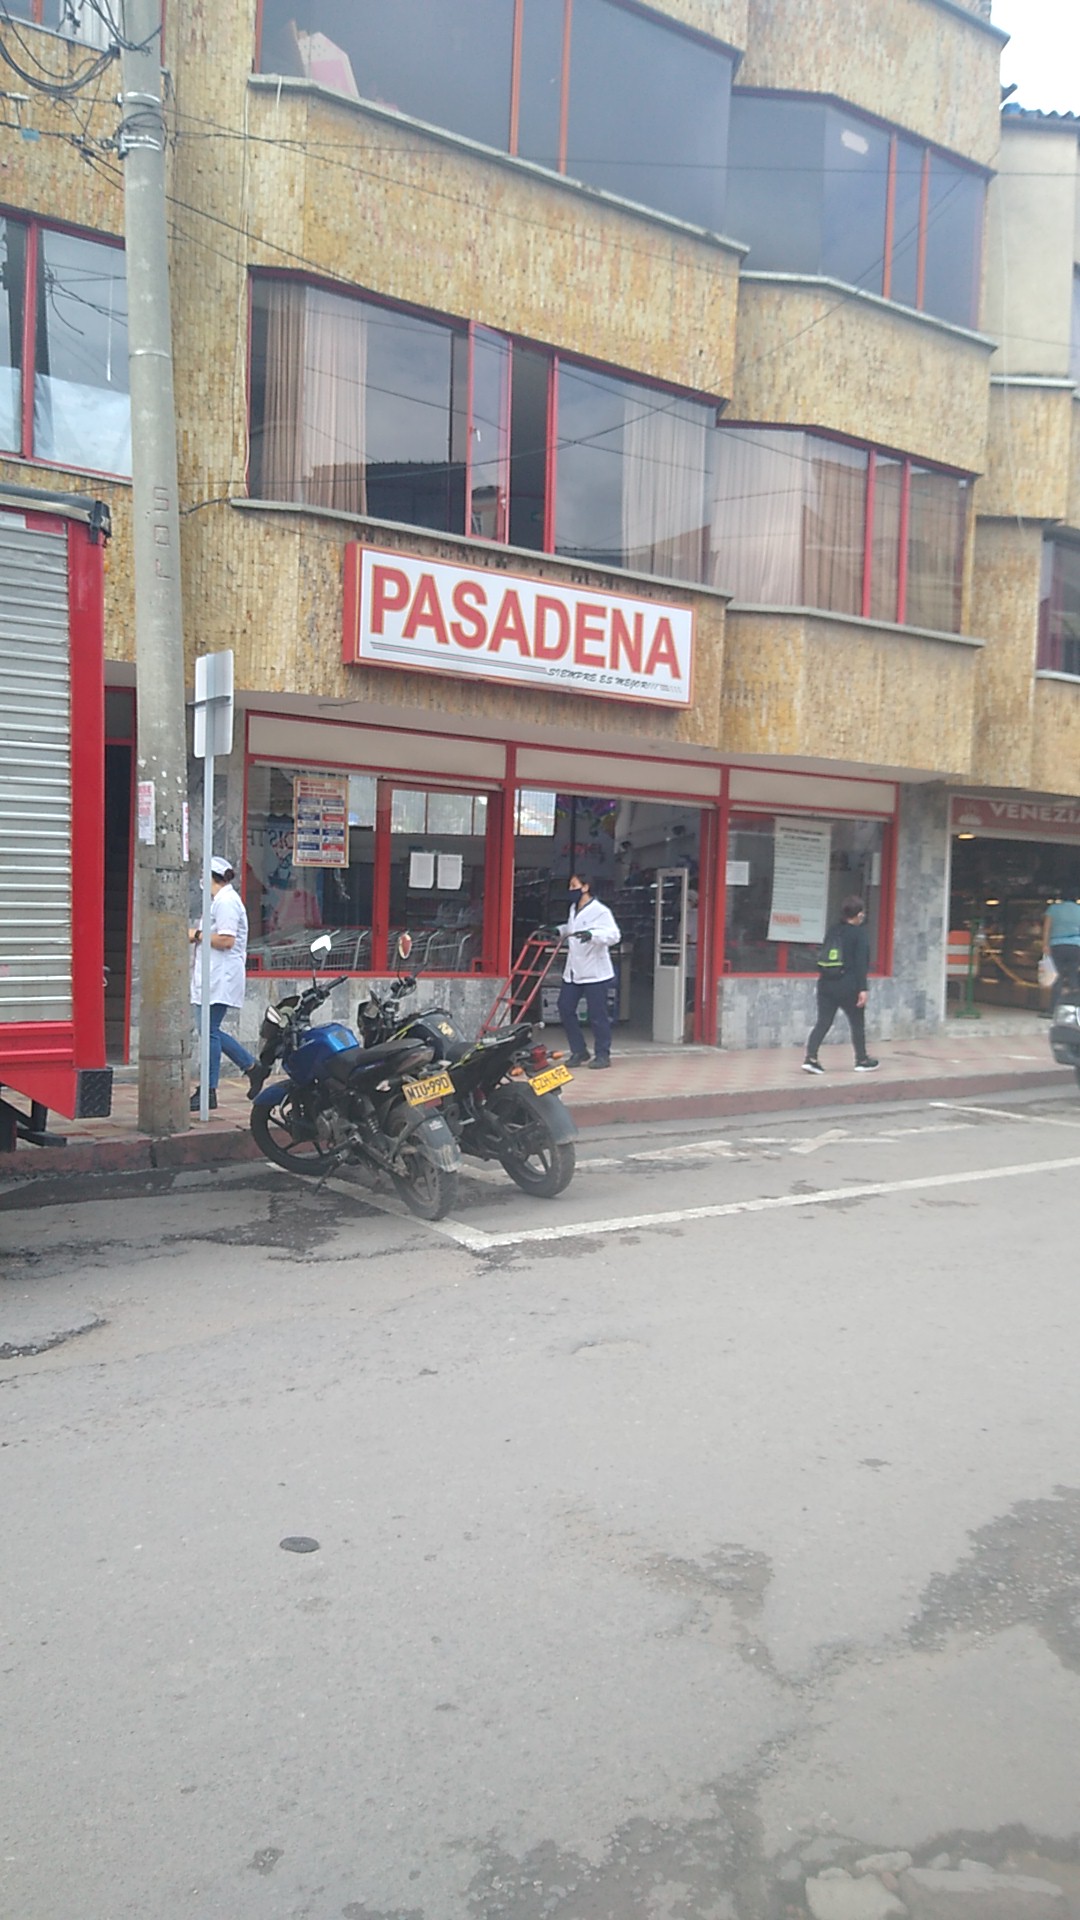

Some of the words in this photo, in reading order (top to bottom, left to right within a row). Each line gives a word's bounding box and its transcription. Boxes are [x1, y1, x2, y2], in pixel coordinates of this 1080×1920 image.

[370, 564, 682, 680] PASADENA
[547, 667, 598, 682] SIEMPRE
[599, 674, 614, 685] ES
